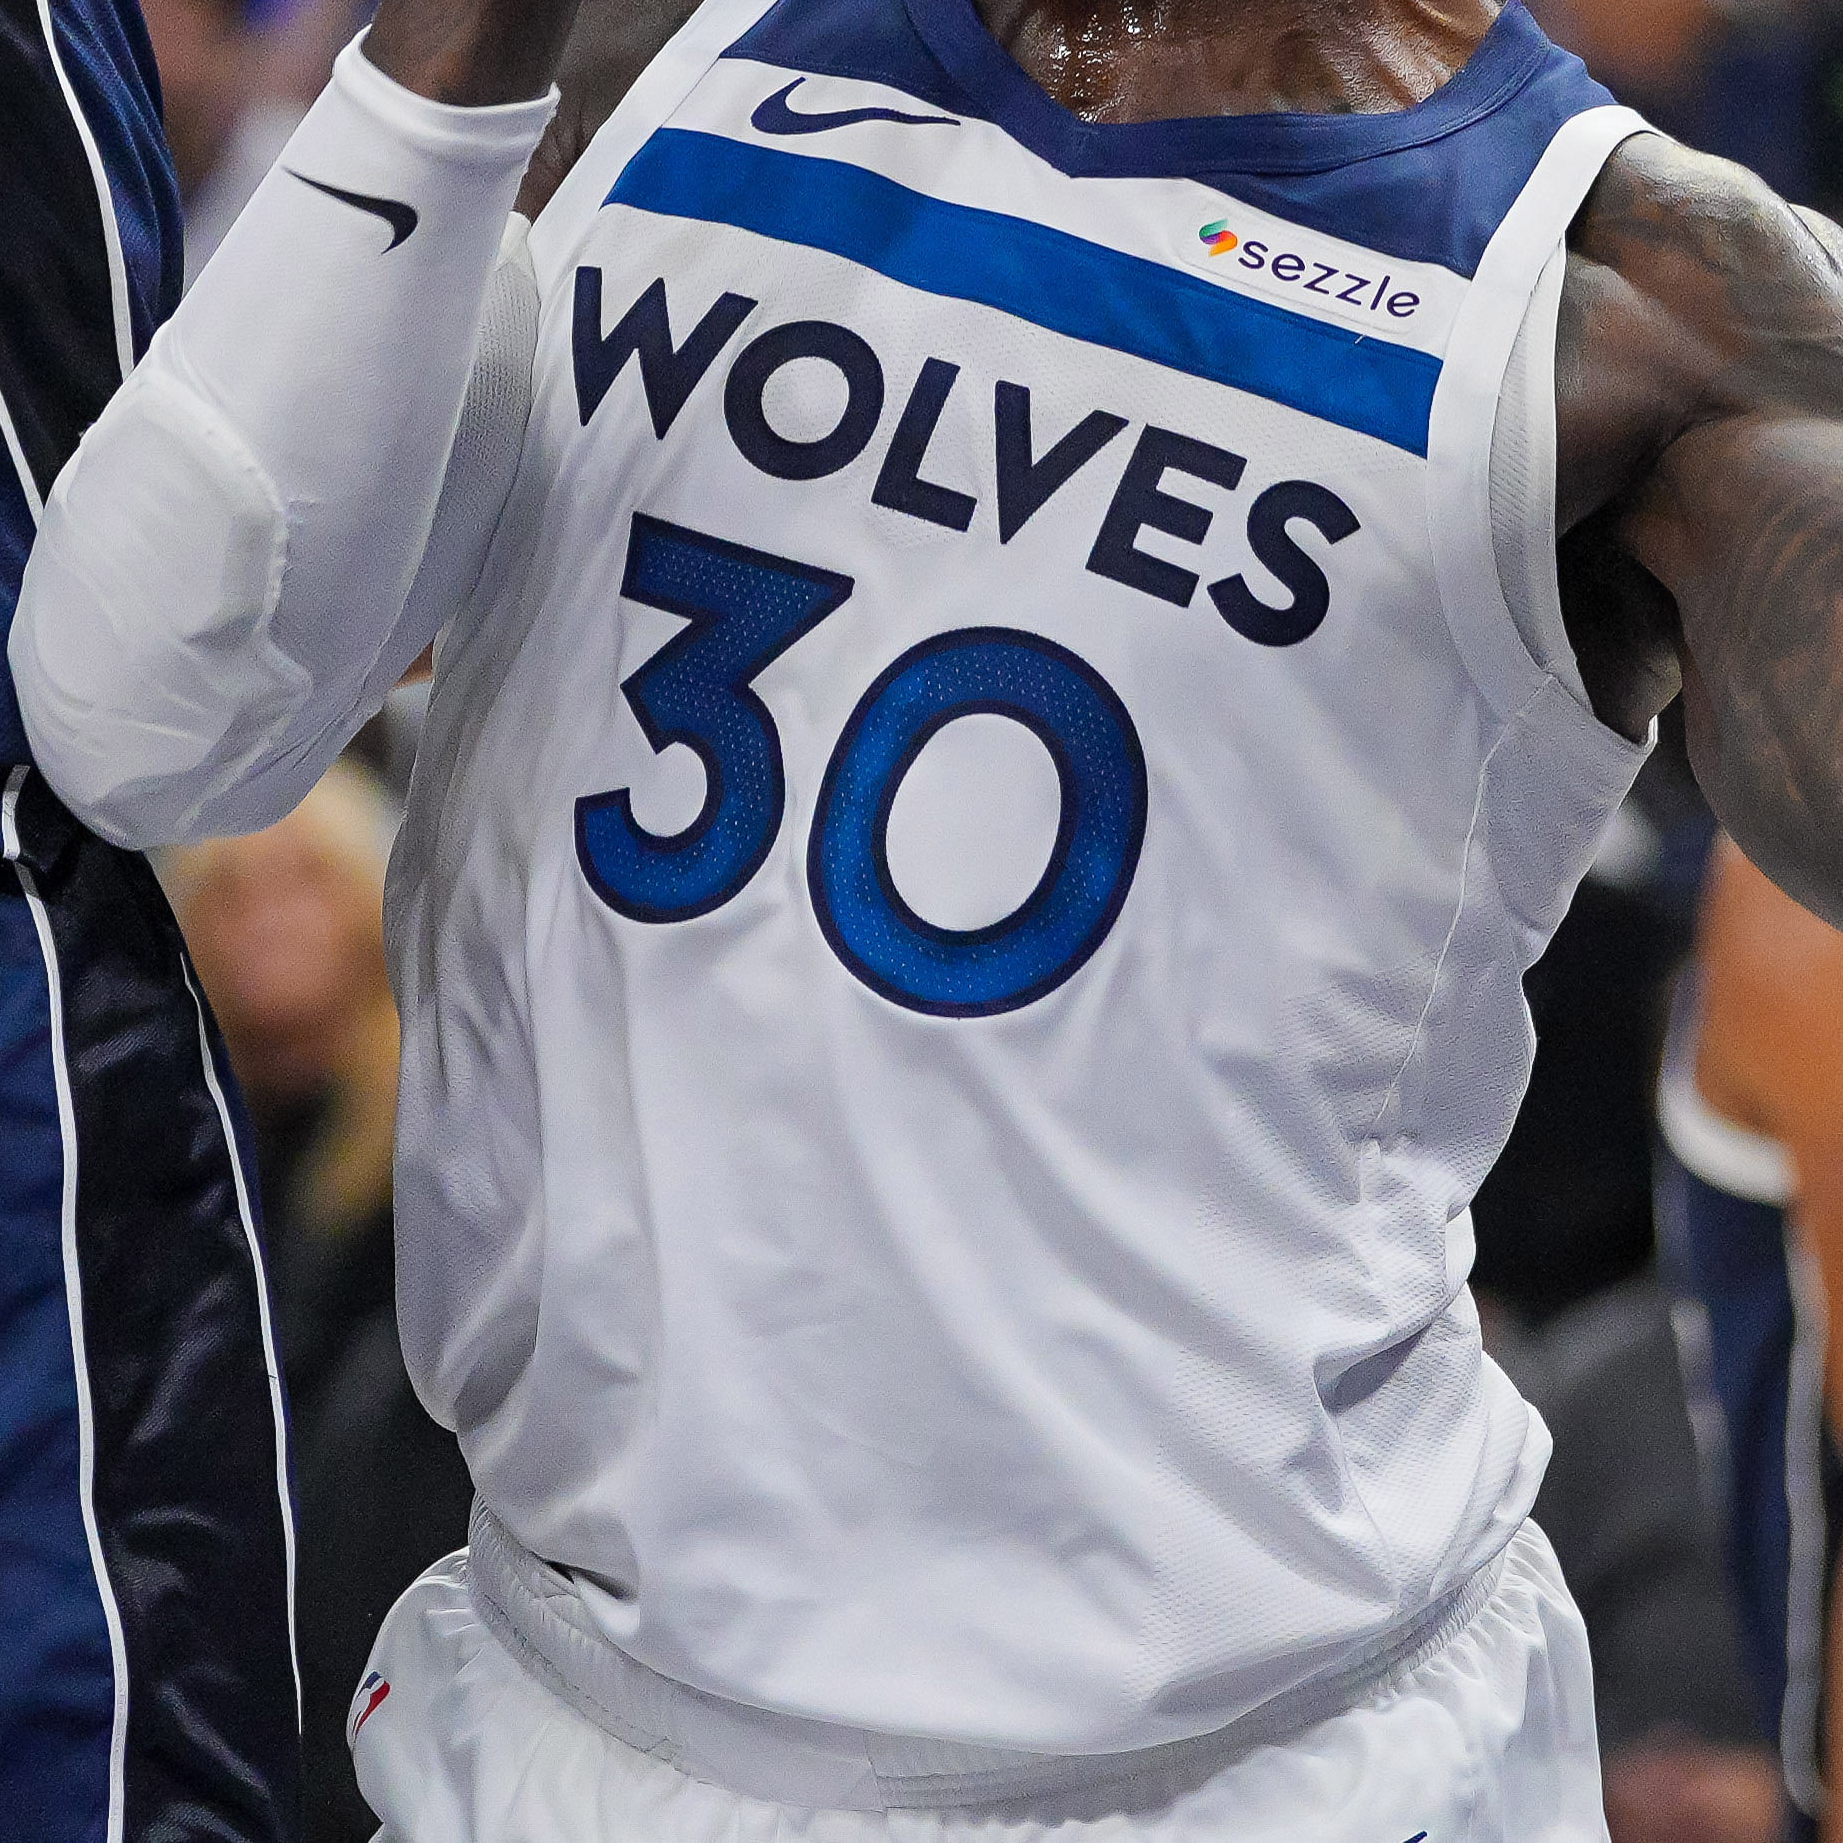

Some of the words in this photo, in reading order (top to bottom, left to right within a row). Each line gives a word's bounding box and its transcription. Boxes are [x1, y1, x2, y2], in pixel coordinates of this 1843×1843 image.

[570, 265, 1361, 648] WOLVES
[1238, 240, 1420, 318] sezzle
[573, 511, 1150, 1018] 30
